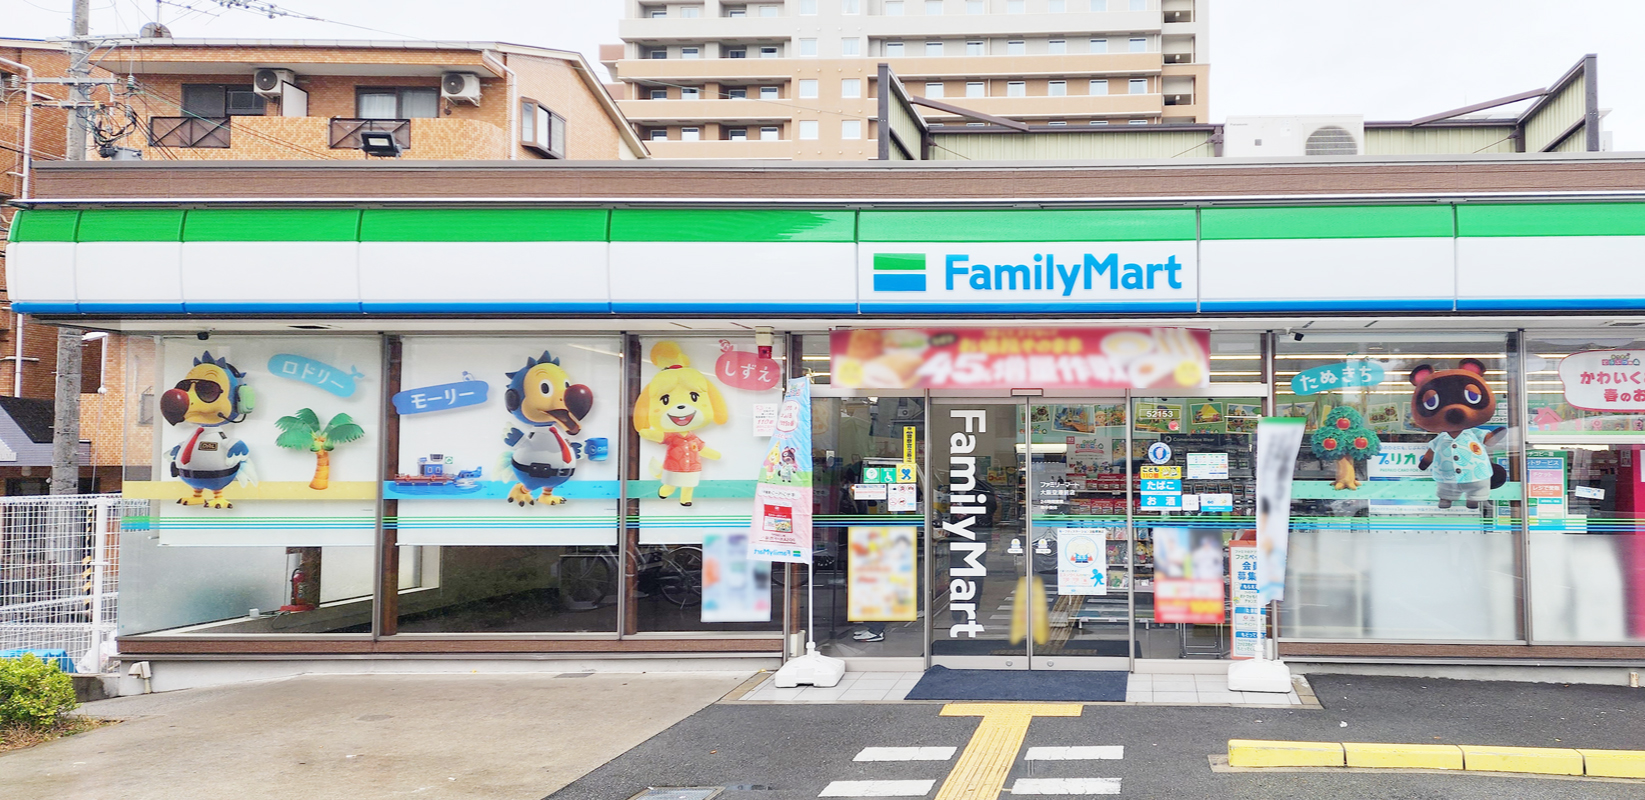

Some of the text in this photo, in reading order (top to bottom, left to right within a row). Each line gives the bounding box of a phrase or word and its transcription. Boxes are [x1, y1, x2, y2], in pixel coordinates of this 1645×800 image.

[945, 253, 1182, 296] FamilyMart
[282, 361, 344, 389] ロドリー
[724, 360, 771, 382] しずえ
[1300, 366, 1372, 391] たぬきち
[411, 388, 475, 409] モーリー
[1146, 410, 1173, 418] 52153
[1146, 481, 1175, 491] たばこ
[942, 409, 987, 638] FamilyMart
